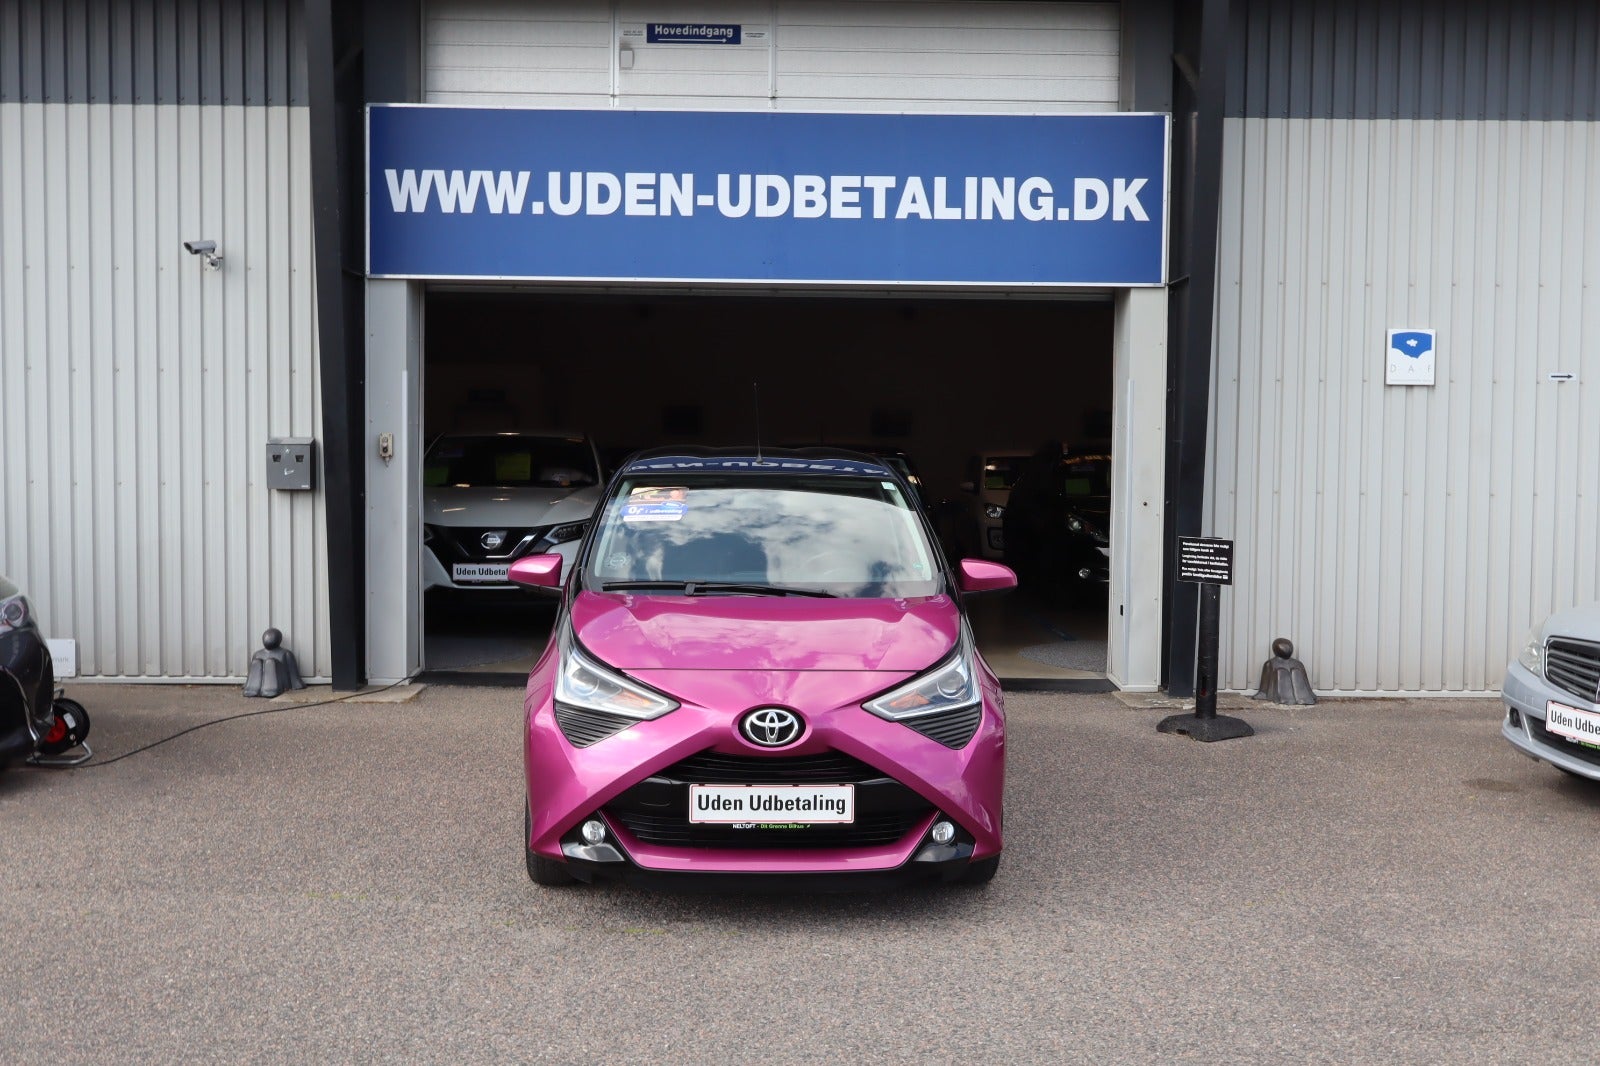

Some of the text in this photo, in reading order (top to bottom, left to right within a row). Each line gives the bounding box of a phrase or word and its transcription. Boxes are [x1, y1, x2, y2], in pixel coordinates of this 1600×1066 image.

[655, 25, 734, 38] Hovedindgang
[384, 168, 1150, 222] WWW.UDEN-UDBETALING.DK
[456, 567, 509, 576] Uden Udbetal
[1551, 710, 1600, 735] Uden Udbe
[697, 794, 846, 815] Uden Udbetaling
